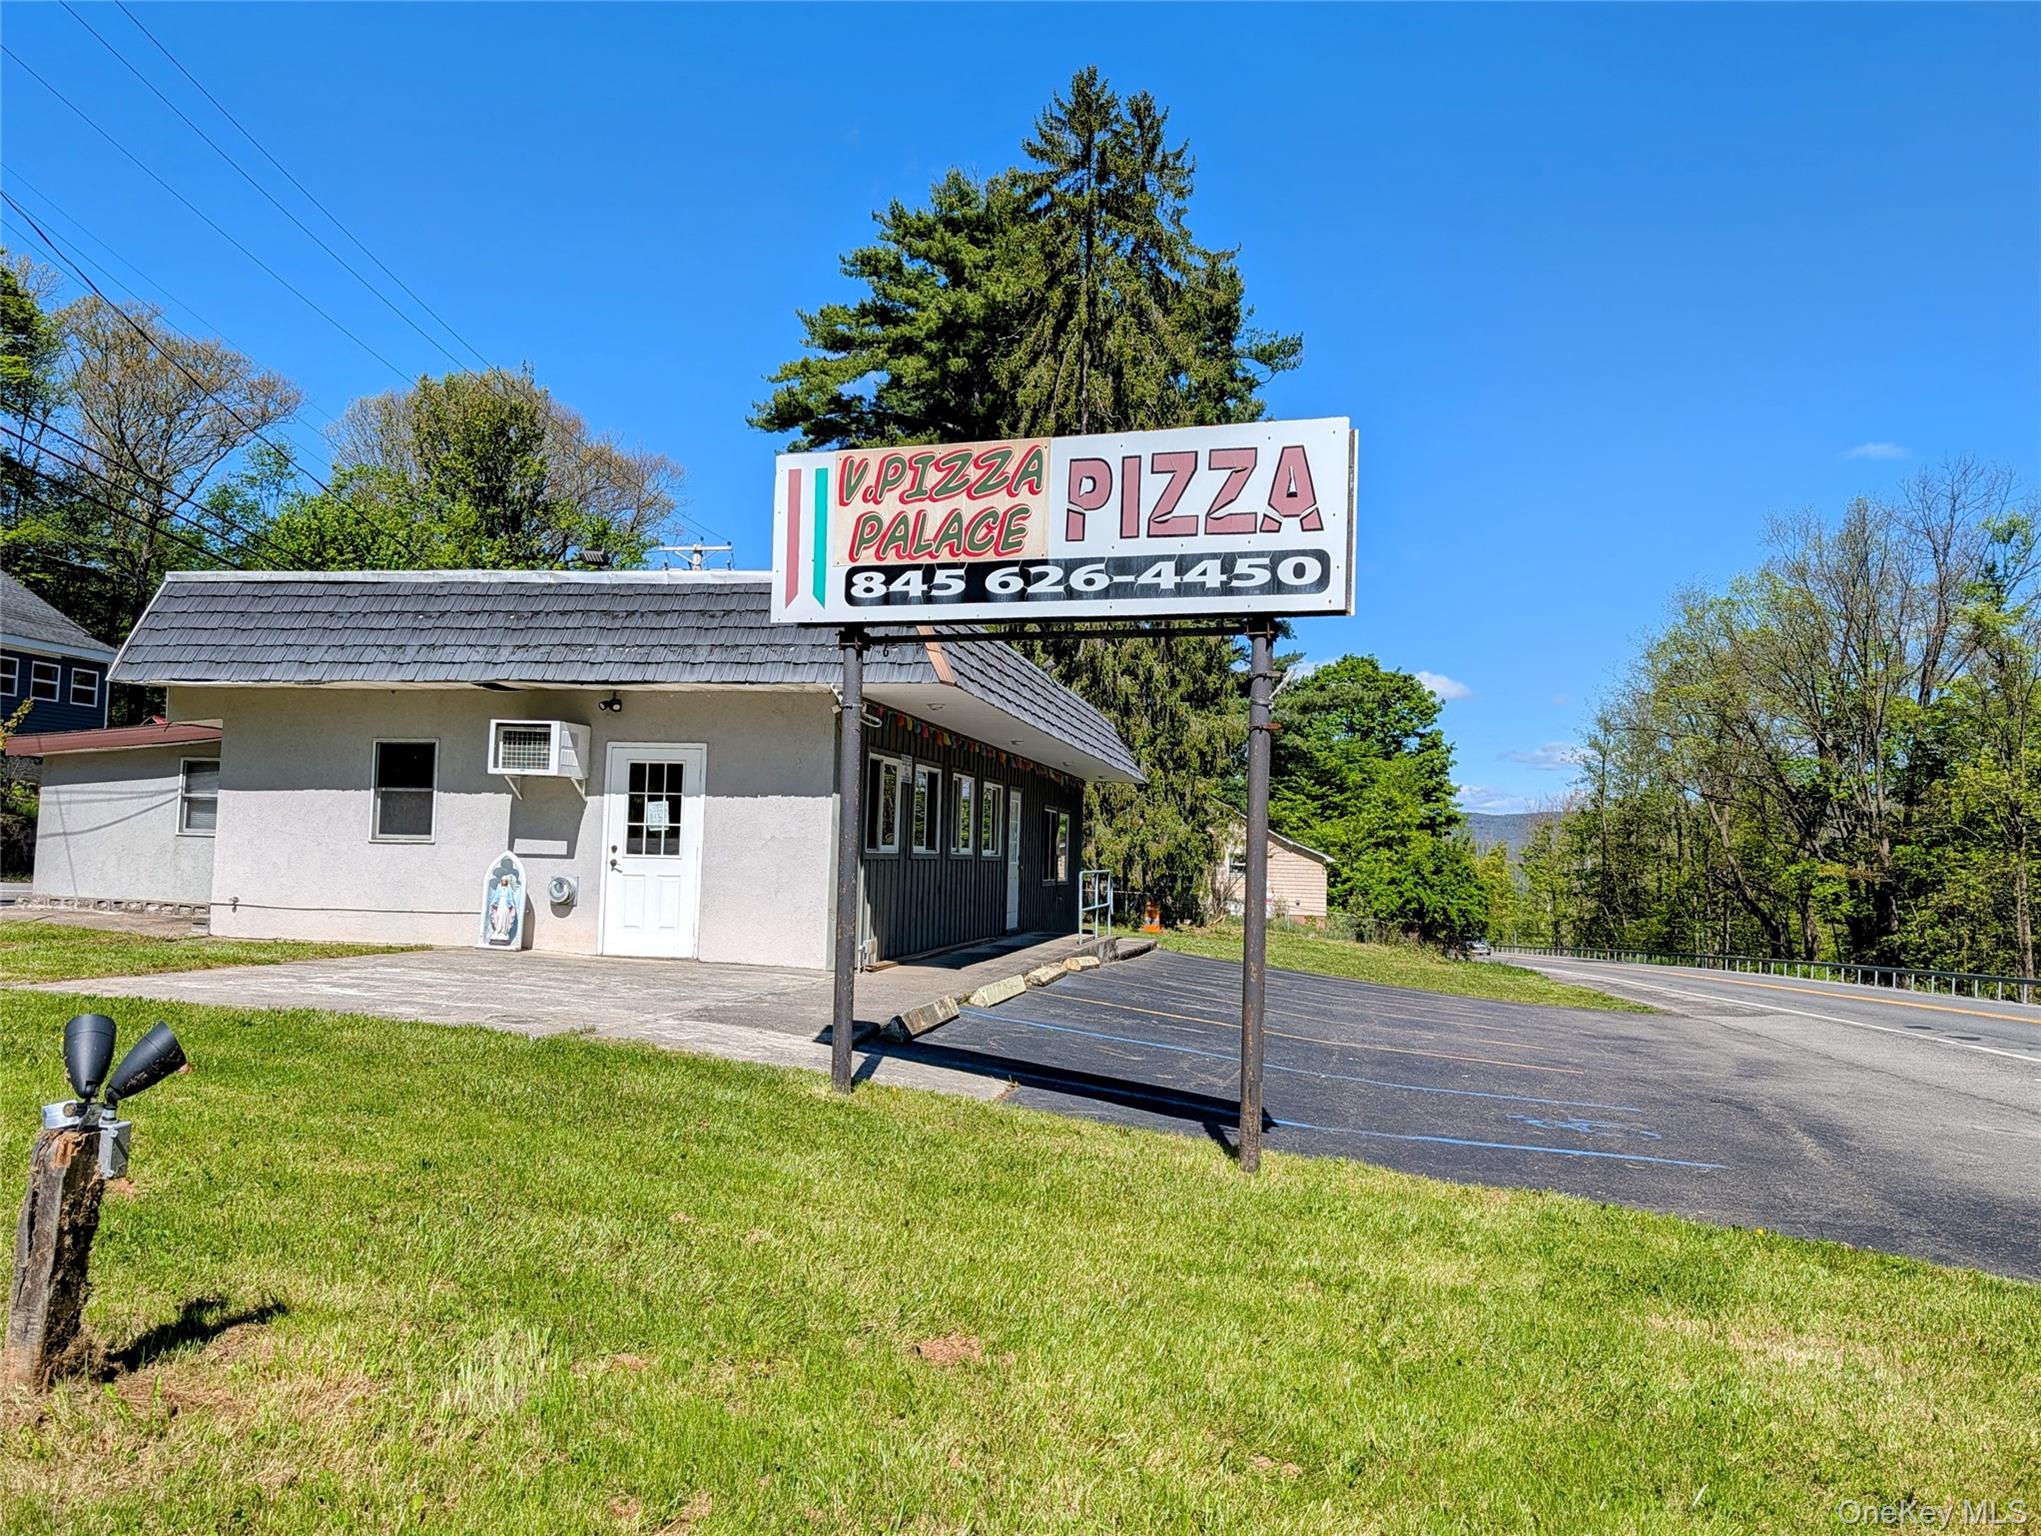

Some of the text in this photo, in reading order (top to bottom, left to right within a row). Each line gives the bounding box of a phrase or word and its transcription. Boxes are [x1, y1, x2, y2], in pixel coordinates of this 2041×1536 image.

[1065, 444, 1325, 542] PIZZA
[848, 503, 1032, 563] PALACE
[850, 555, 1323, 598] 845 626-4450
